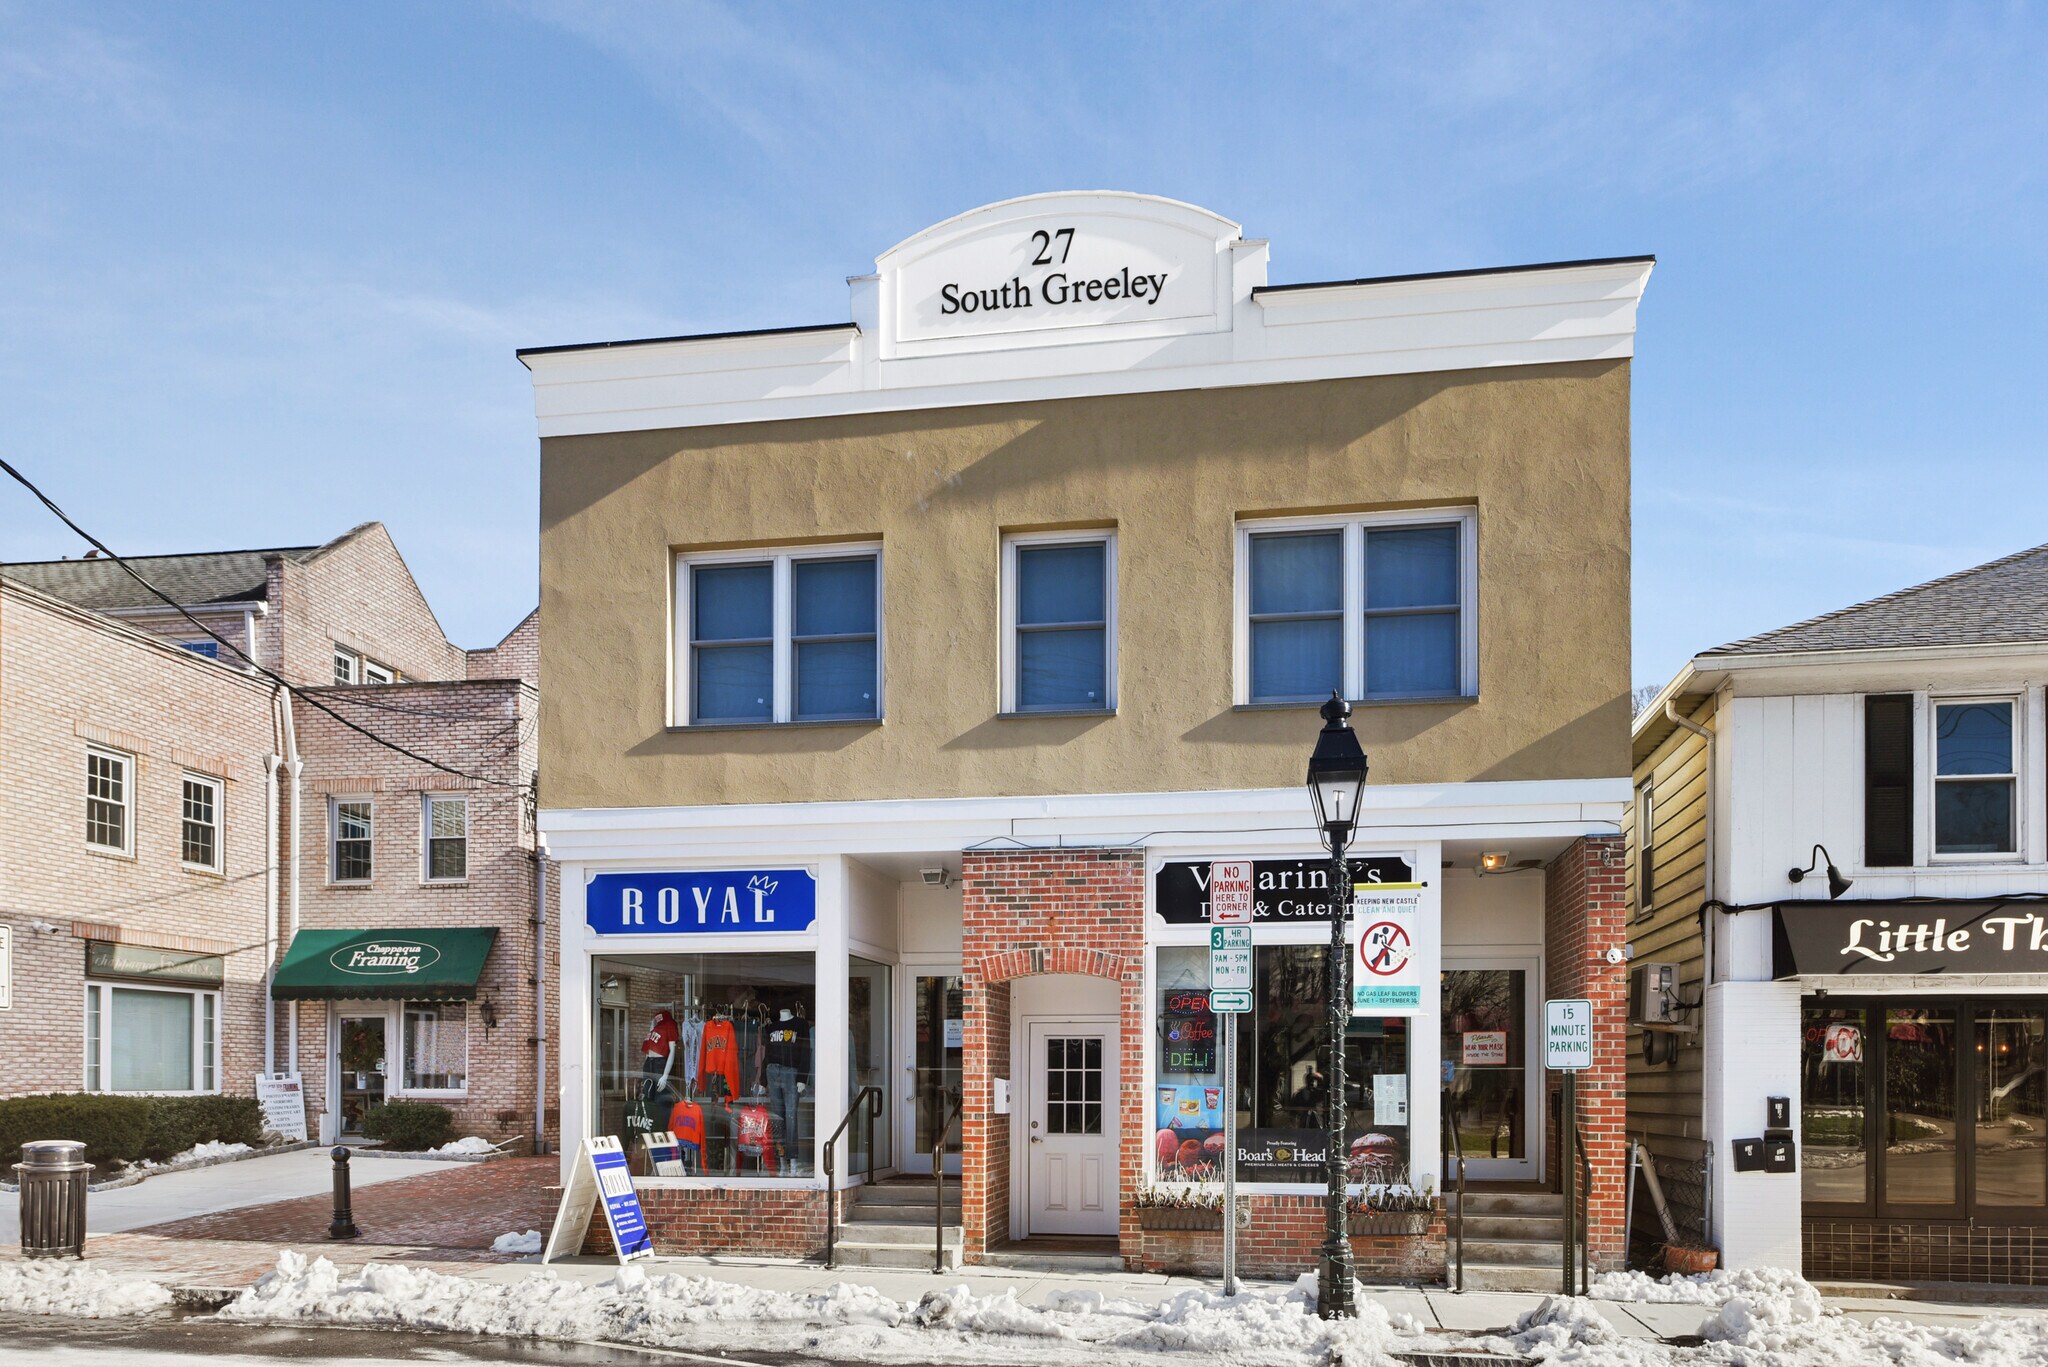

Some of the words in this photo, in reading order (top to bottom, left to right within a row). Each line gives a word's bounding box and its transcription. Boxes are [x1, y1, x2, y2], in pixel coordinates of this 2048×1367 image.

[1031, 228, 1076, 266] 27
[941, 277, 1033, 315] South
[1042, 267, 1168, 306] Greeley
[1188, 862, 1382, 891] Varin's
[1224, 866, 1239, 878] NO
[1214, 880, 1250, 892] PARKING
[1216, 893, 1236, 902] HERE
[1239, 893, 1248, 902] TO
[1396, 897, 1418, 905] CASTLE
[622, 886, 775, 925] ROYAL
[1216, 903, 1248, 911] CORNER
[1253, 900, 1271, 917] &
[1358, 906, 1380, 914] CLEAN
[1382, 906, 1396, 914] AND
[1397, 905, 1417, 914] QUIET
[1213, 931, 1223, 948] 3
[1232, 929, 1242, 938] HR
[1224, 939, 1250, 948] PARKING
[1840, 918, 1971, 962] Little
[366, 944, 422, 956] Chappaqua
[348, 950, 421, 974] Framing
[1214, 954, 1228, 963] 9AM
[1235, 954, 1248, 963] 5PM
[1216, 966, 1230, 975] MON
[1236, 966, 1247, 974] FRI
[1169, 997, 1210, 1010] OPEN
[1562, 1008, 1574, 1020] 15
[1181, 1021, 1214, 1041] Coffee
[1551, 1024, 1586, 1036] MINUTE
[1549, 1041, 1588, 1053] PARKING
[1170, 1052, 1208, 1067] DELI
[1237, 1147, 1273, 1162] Boar's
[1292, 1147, 1327, 1162] Head
